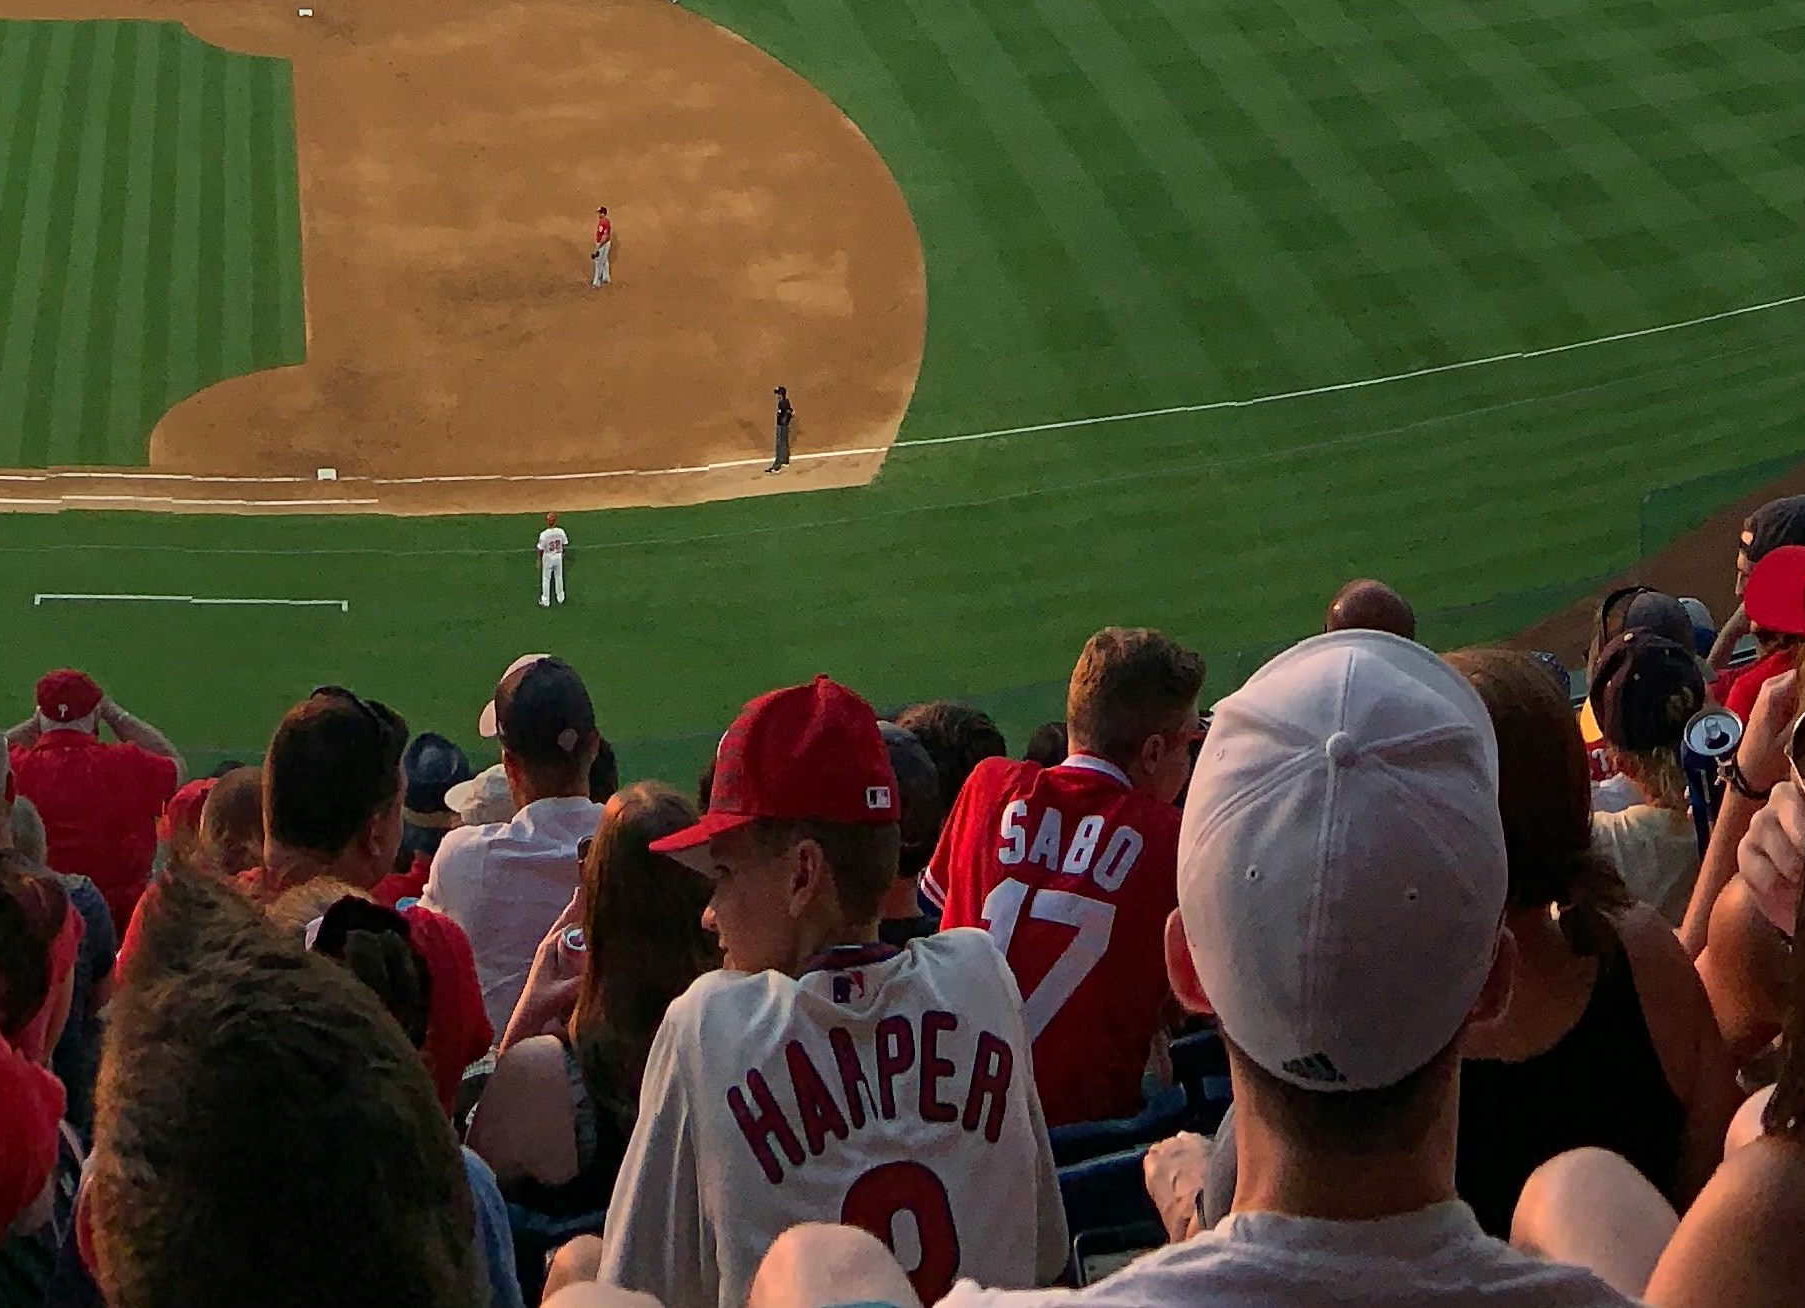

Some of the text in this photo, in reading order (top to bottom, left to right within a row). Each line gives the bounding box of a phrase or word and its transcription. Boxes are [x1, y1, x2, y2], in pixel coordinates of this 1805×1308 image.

[997, 796, 1145, 893] SABO
[981, 878, 1117, 1045] 17
[727, 1009, 1014, 1184] HARPER
